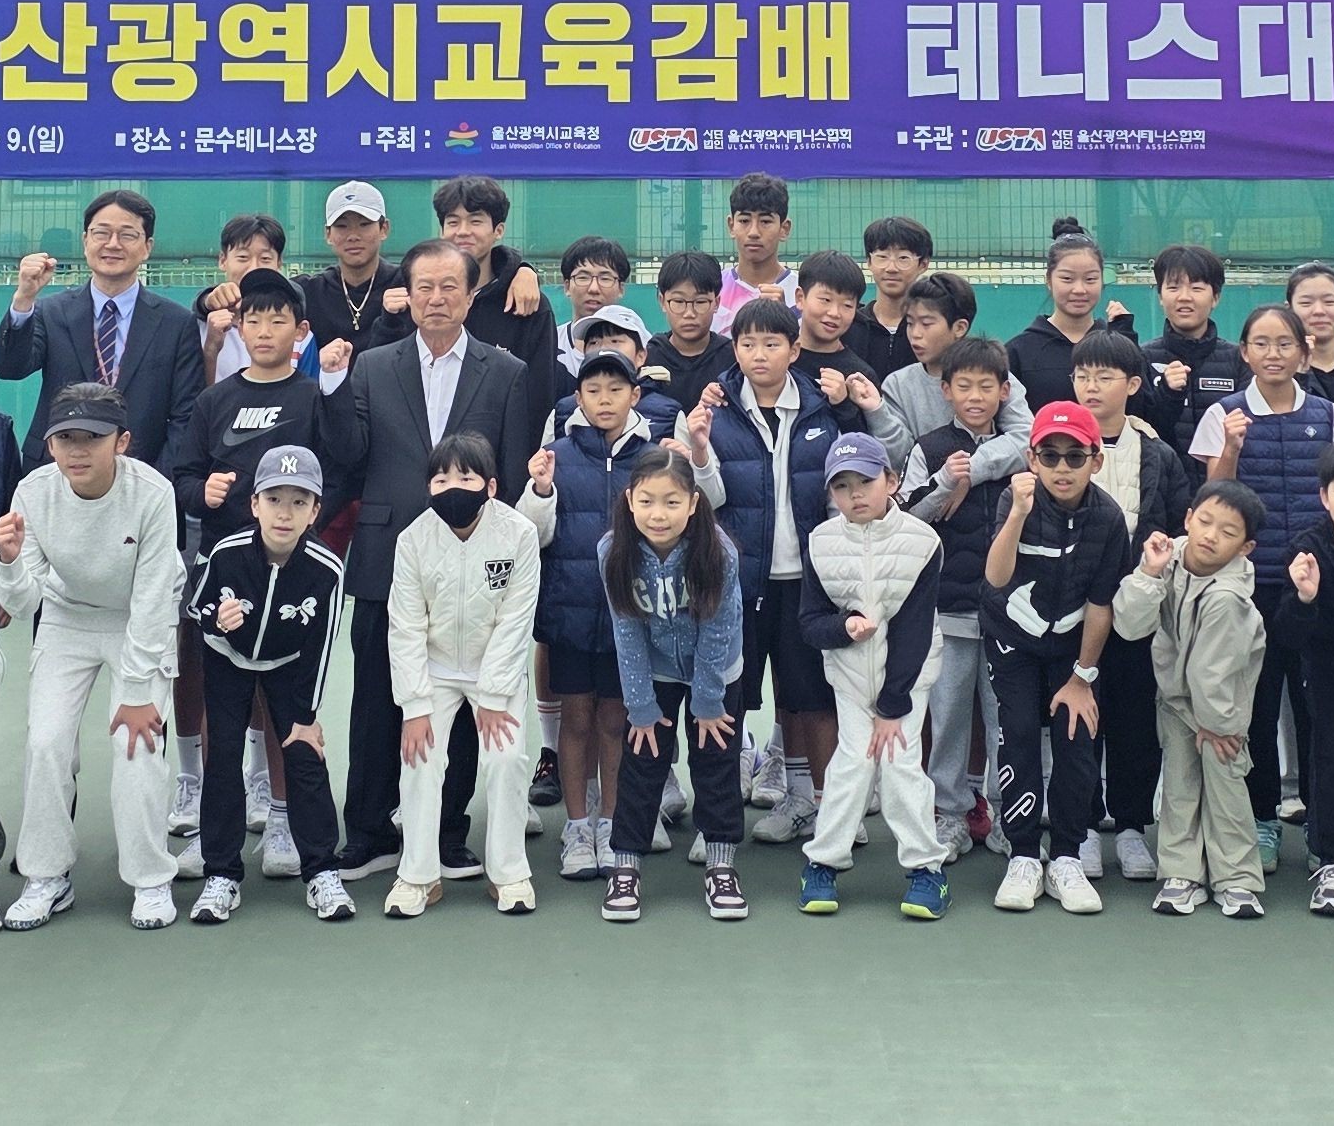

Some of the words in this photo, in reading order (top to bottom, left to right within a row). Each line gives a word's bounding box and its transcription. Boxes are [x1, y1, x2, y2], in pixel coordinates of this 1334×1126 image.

[6, 125, 65, 155] 9.(일)
[130, 126, 172, 154] 장소
[194, 126, 318, 154] 문수테니스장
[375, 125, 416, 153] 주최
[491, 125, 600, 141] 울산광역시교육청
[628, 127, 698, 152] USTA
[912, 125, 954, 151] 주관
[975, 127, 1047, 152] USTA
[727, 143, 756, 151] ULSAN
[759, 143, 790, 151] TENNIS
[793, 142, 852, 151] ASSOCIATION
[1076, 143, 1106, 151] ULSAN
[1109, 143, 1141, 151] TENNIS
[1145, 143, 1206, 151] ASSOCIATION
[231, 406, 283, 429] NIKE
[280, 455, 298, 474] NY
